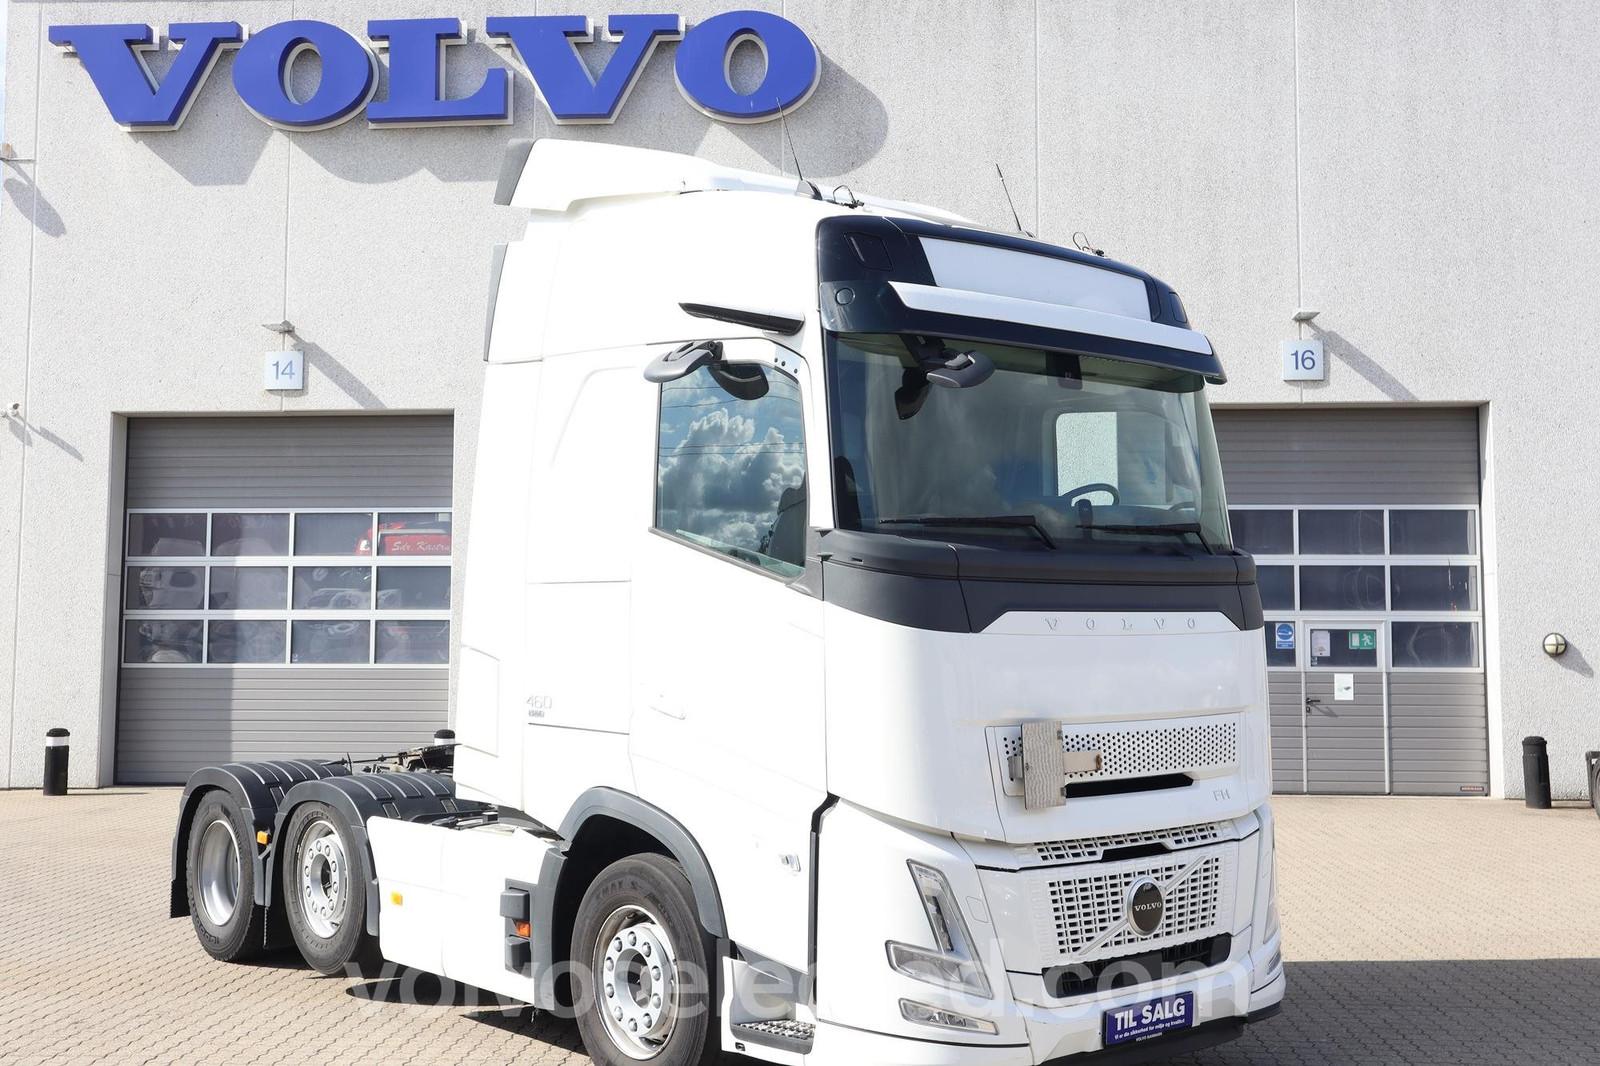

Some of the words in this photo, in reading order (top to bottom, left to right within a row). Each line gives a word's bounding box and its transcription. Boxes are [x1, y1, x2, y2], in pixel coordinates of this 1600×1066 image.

[48, 10, 821, 131] VOLVO
[1290, 349, 1316, 370] 16
[271, 360, 296, 380] 14
[1044, 617, 1196, 632] VOLVO
[1134, 901, 1162, 912] VOLVO
[1114, 1009, 1138, 1031] TIL
[1141, 998, 1186, 1025] SALG
